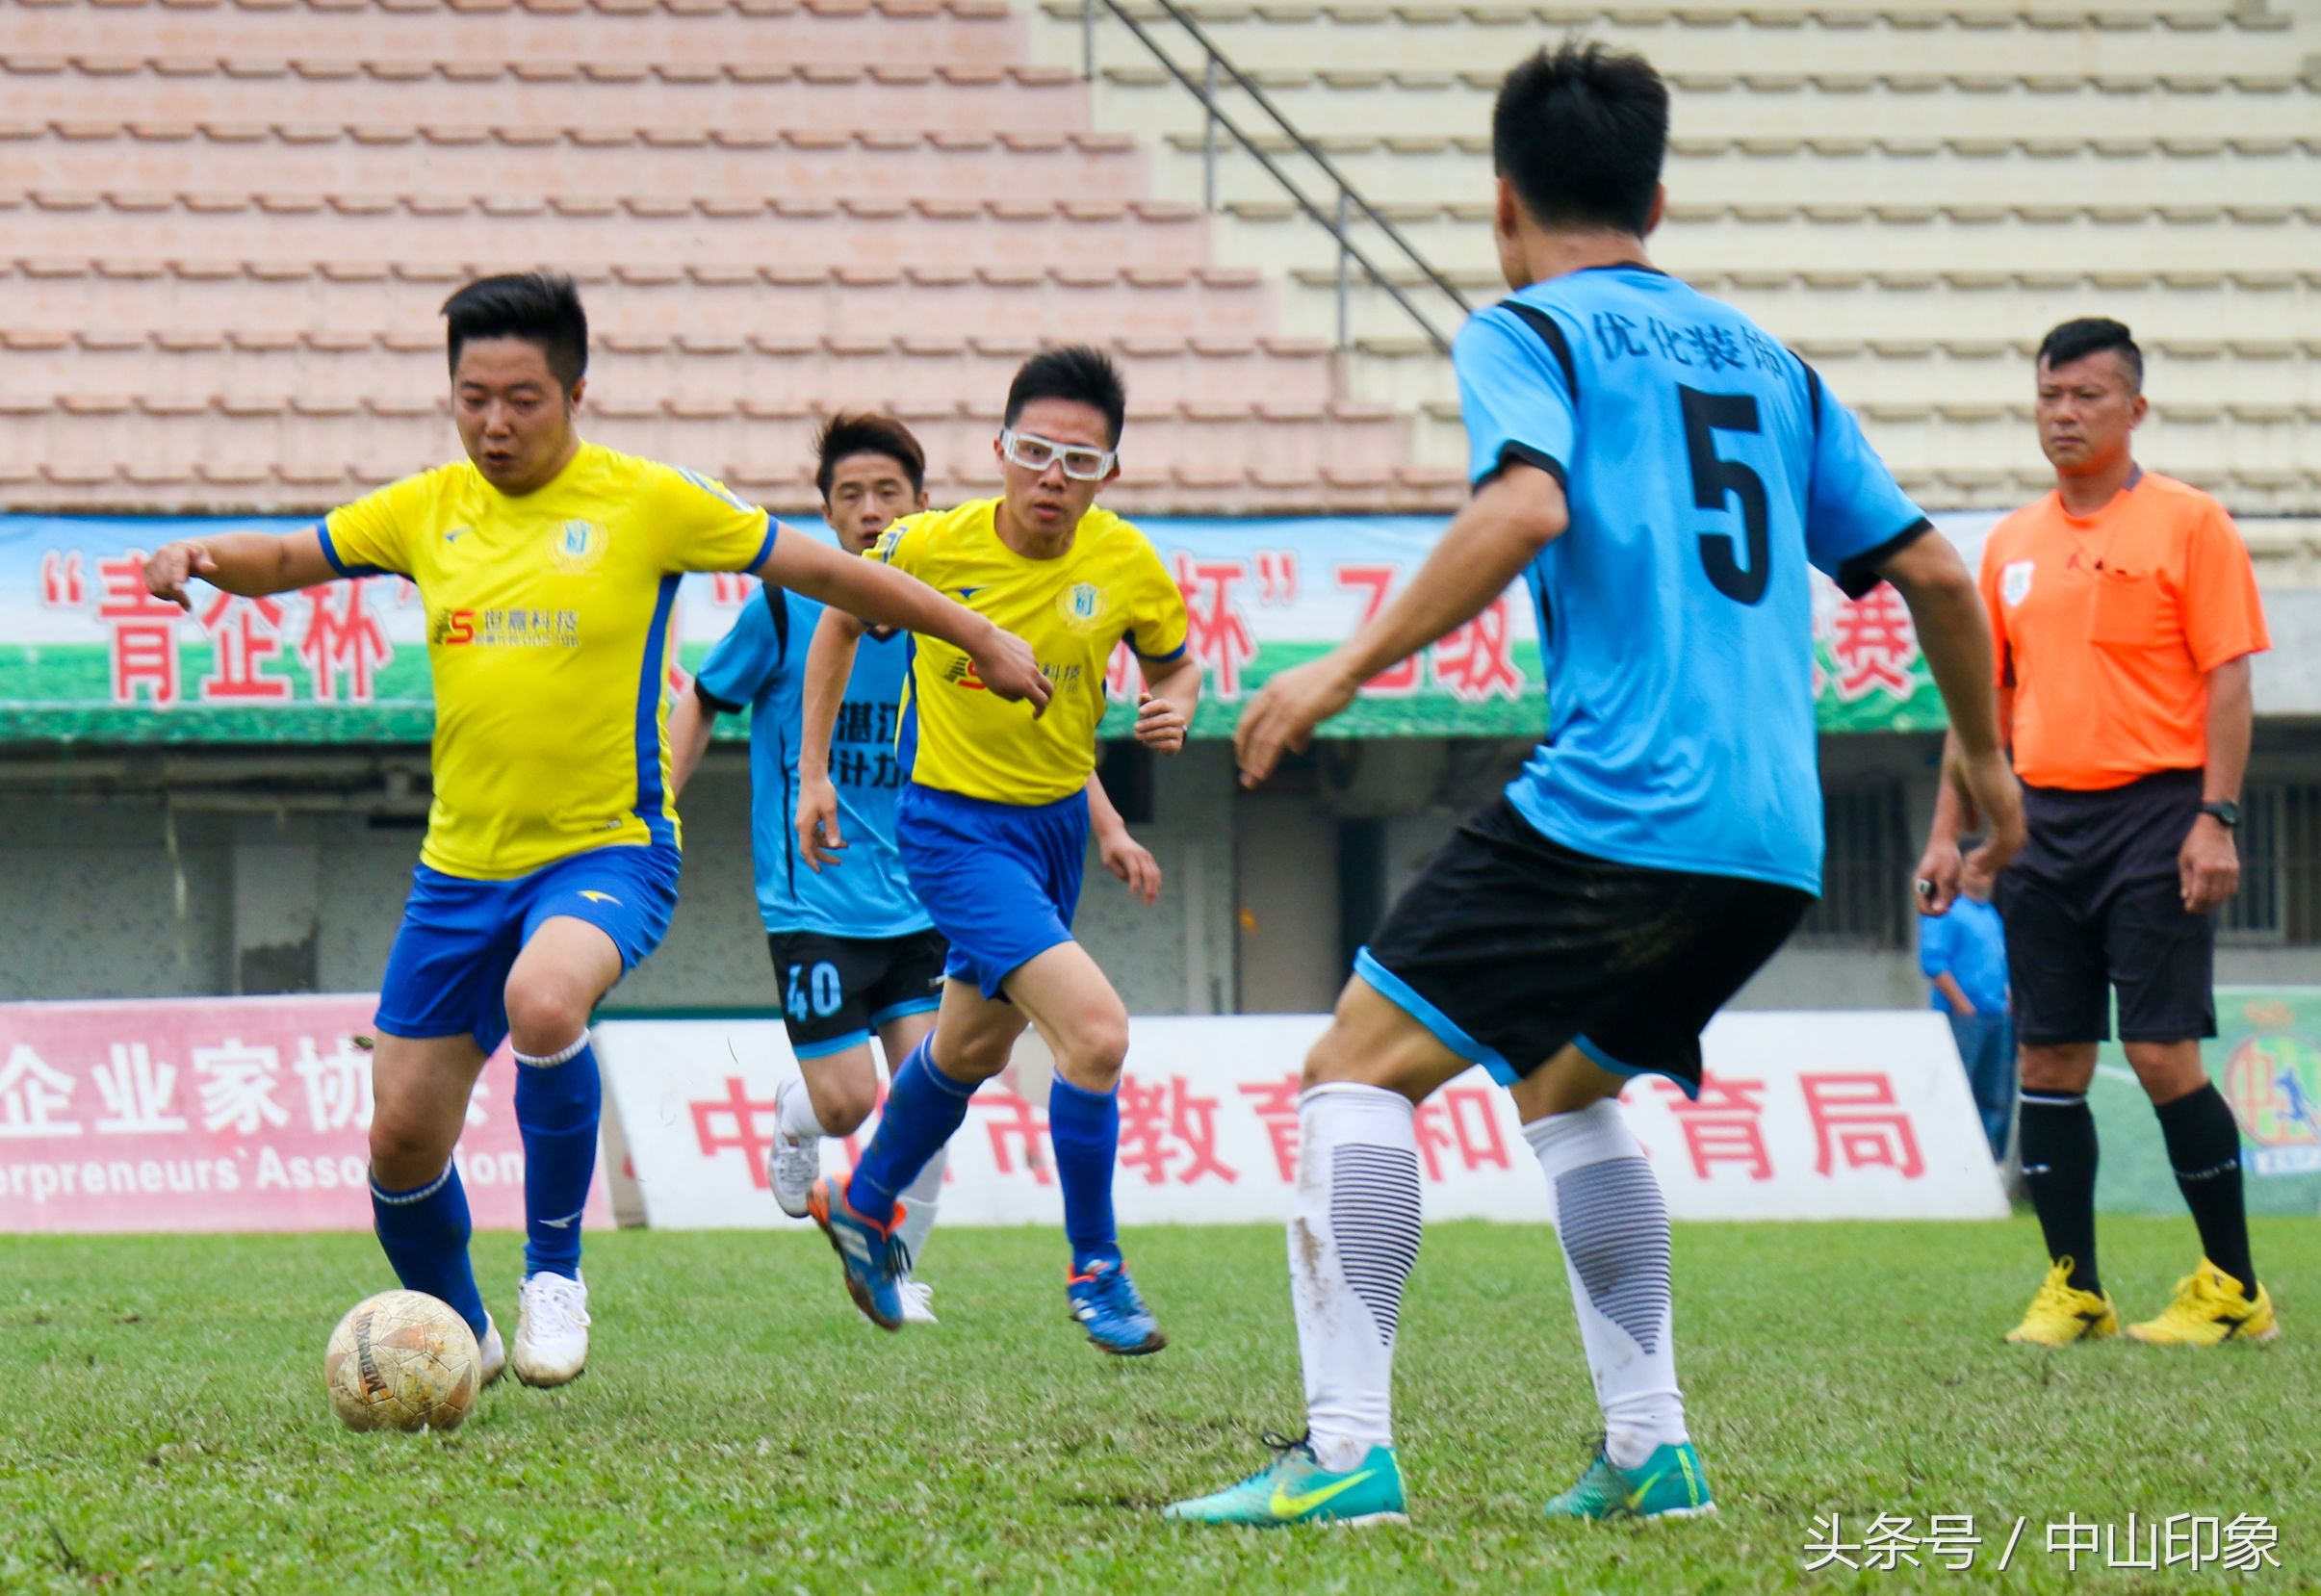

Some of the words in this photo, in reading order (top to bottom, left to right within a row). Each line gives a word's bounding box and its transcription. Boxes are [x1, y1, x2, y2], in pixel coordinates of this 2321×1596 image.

[1675, 381, 1770, 606] 5
[787, 961, 843, 1022] 40
[0, 1037, 489, 1139] 企业家协
